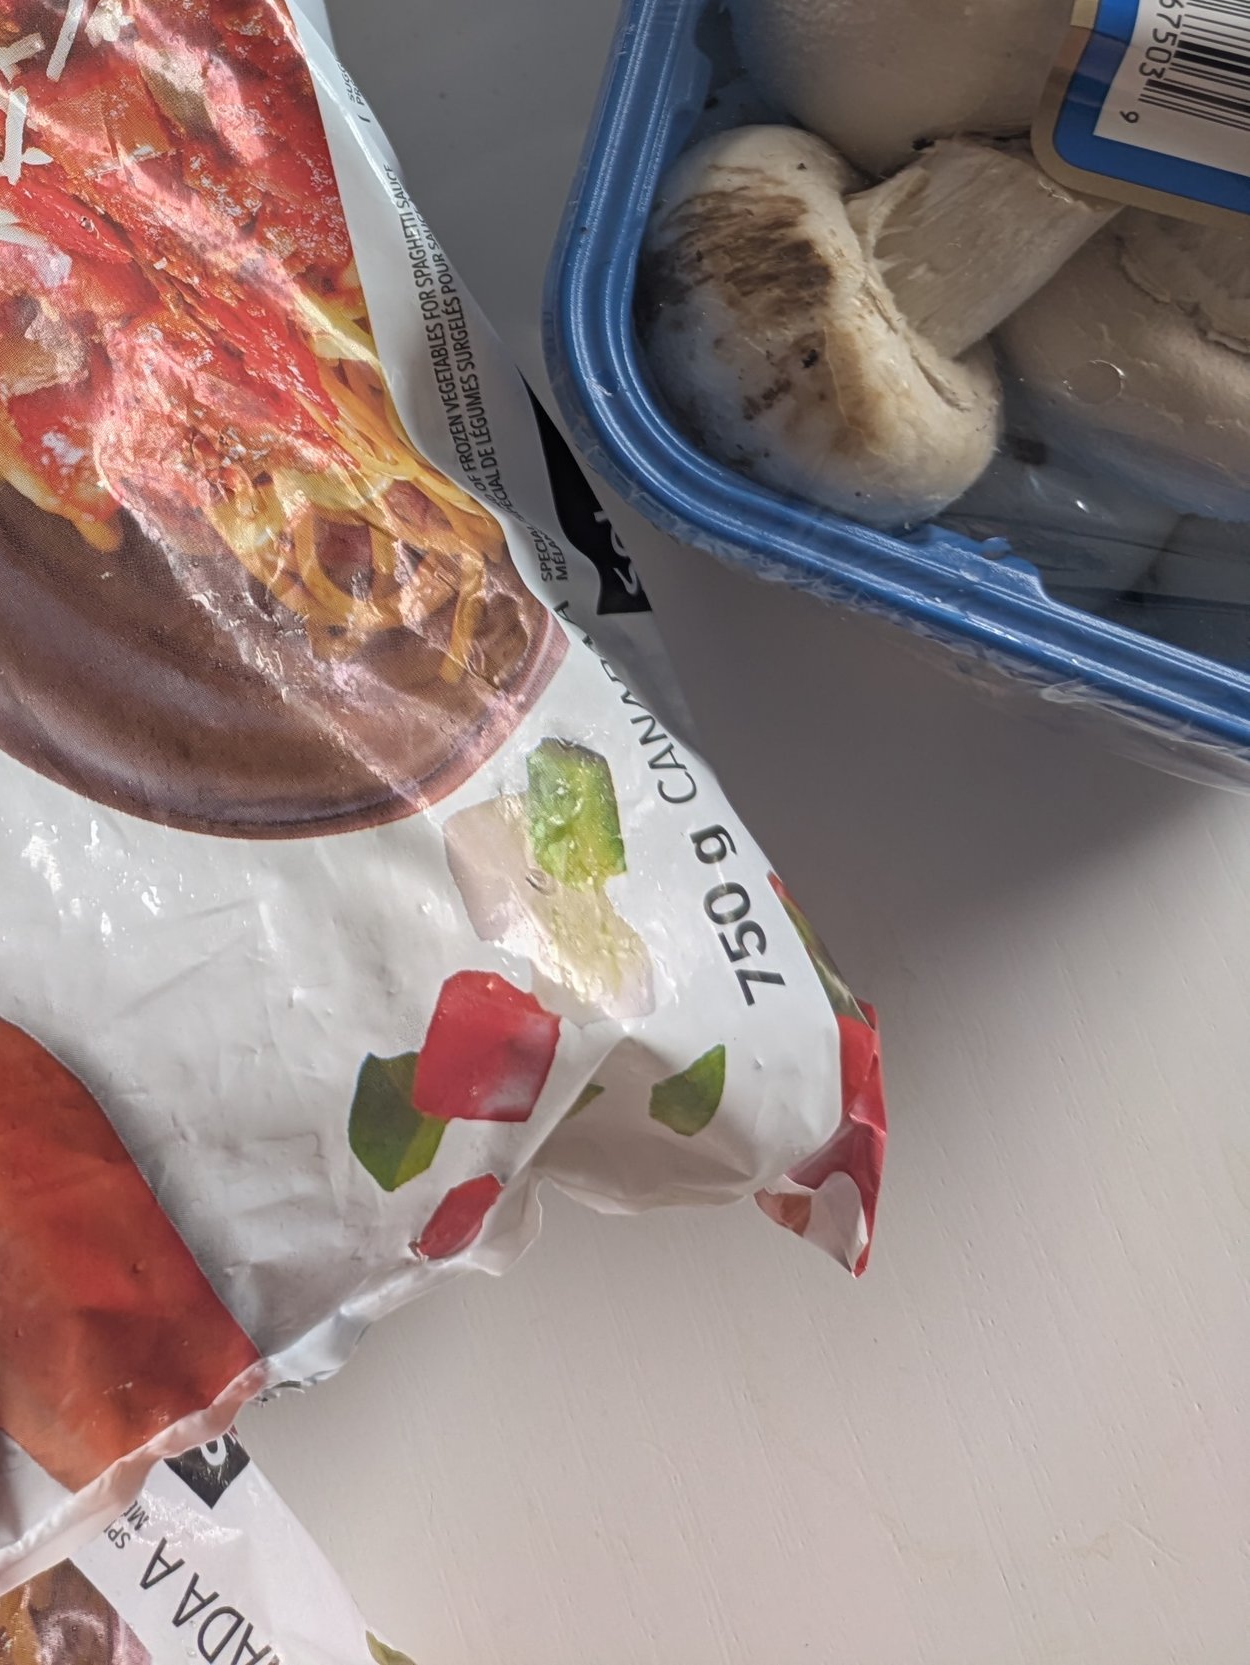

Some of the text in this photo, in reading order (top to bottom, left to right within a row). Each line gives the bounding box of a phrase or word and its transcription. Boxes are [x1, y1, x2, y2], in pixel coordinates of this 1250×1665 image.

[399, 208, 433, 289] SPAGHETTI
[432, 254, 458, 293] POUR
[419, 292, 440, 320] FOR
[442, 292, 477, 372] SURGELÉS
[426, 322, 461, 416] VEGETABLES
[461, 373, 492, 445] LÉGUMES
[449, 417, 477, 472] FROZEN
[478, 447, 497, 469] DE
[690, 823, 738, 865] g
[704, 881, 786, 1006] 750
[139, 1537, 185, 1589] A
